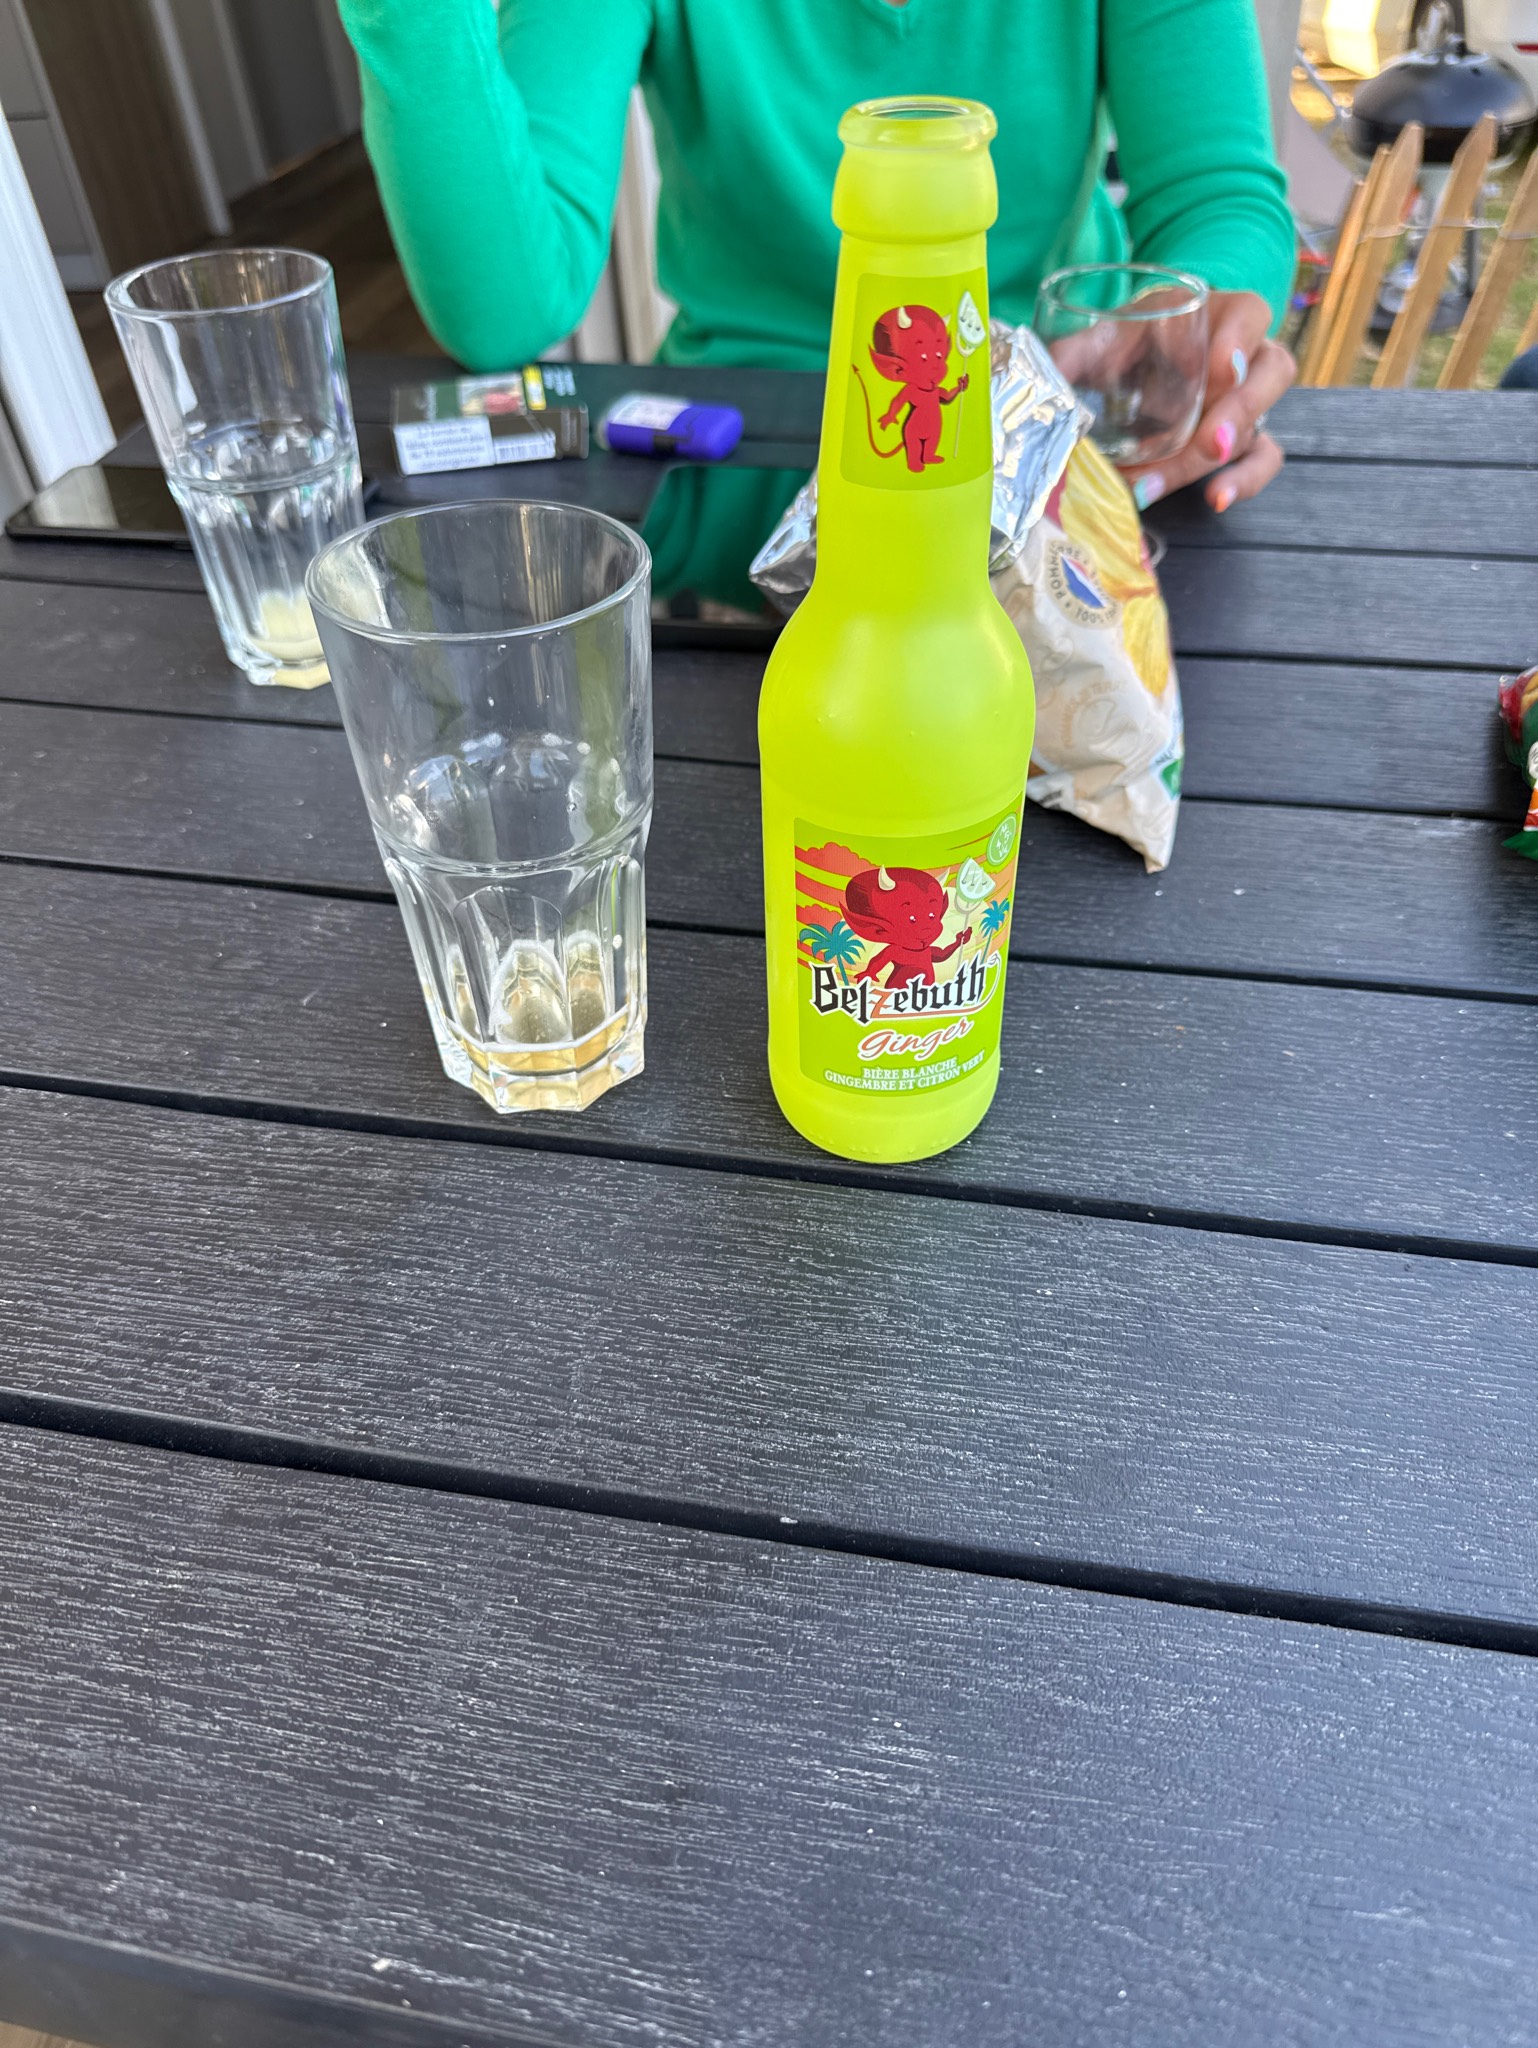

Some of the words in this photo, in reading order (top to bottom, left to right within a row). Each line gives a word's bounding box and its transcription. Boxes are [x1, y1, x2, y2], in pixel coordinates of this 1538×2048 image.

[811, 953, 987, 1024] Belzebuth
[824, 1069, 897, 1091] GINGEMBRE
[899, 1079, 915, 1091] ET
[917, 1068, 961, 1089] CITRON
[961, 1050, 985, 1073] VERT
[862, 1066, 900, 1080] BIÈRE
[901, 1056, 958, 1080] BLANCHE
